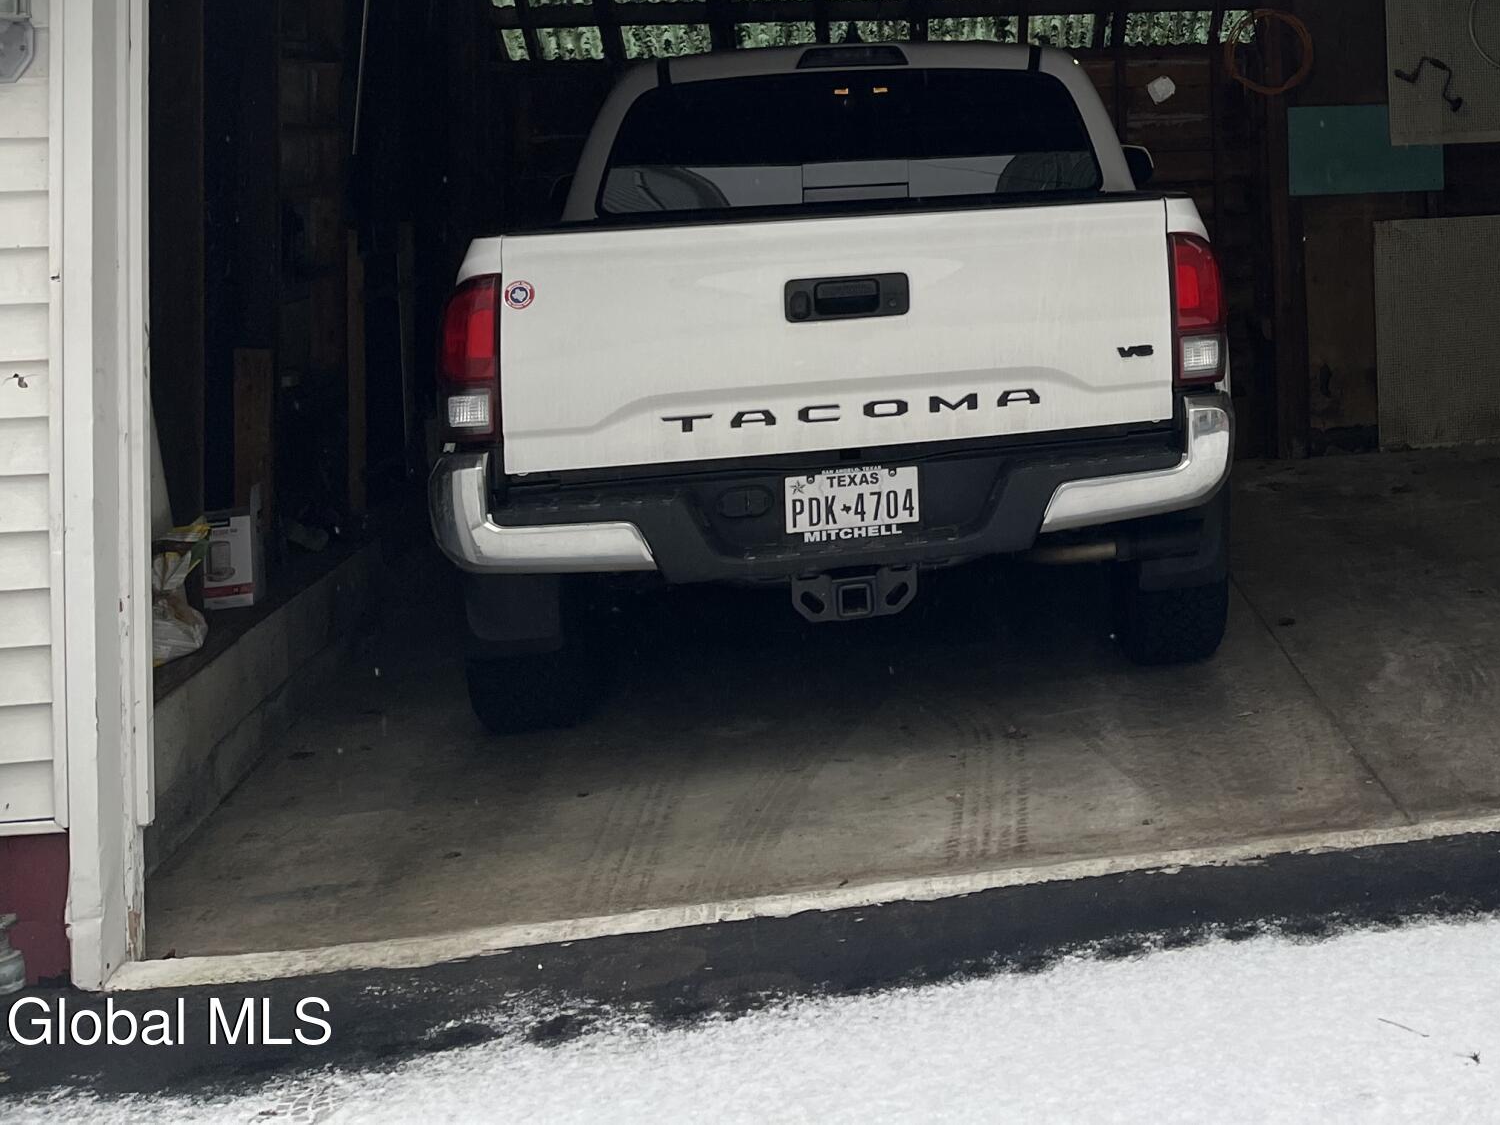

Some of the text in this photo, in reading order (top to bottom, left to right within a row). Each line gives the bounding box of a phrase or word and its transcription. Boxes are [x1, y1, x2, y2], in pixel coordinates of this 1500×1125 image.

[1117, 345, 1154, 357] V6
[661, 388, 1041, 433] TACOMA
[826, 472, 880, 488] TEXAS
[791, 488, 915, 528] PDK 4704
[803, 523, 903, 543] MITCHELL
